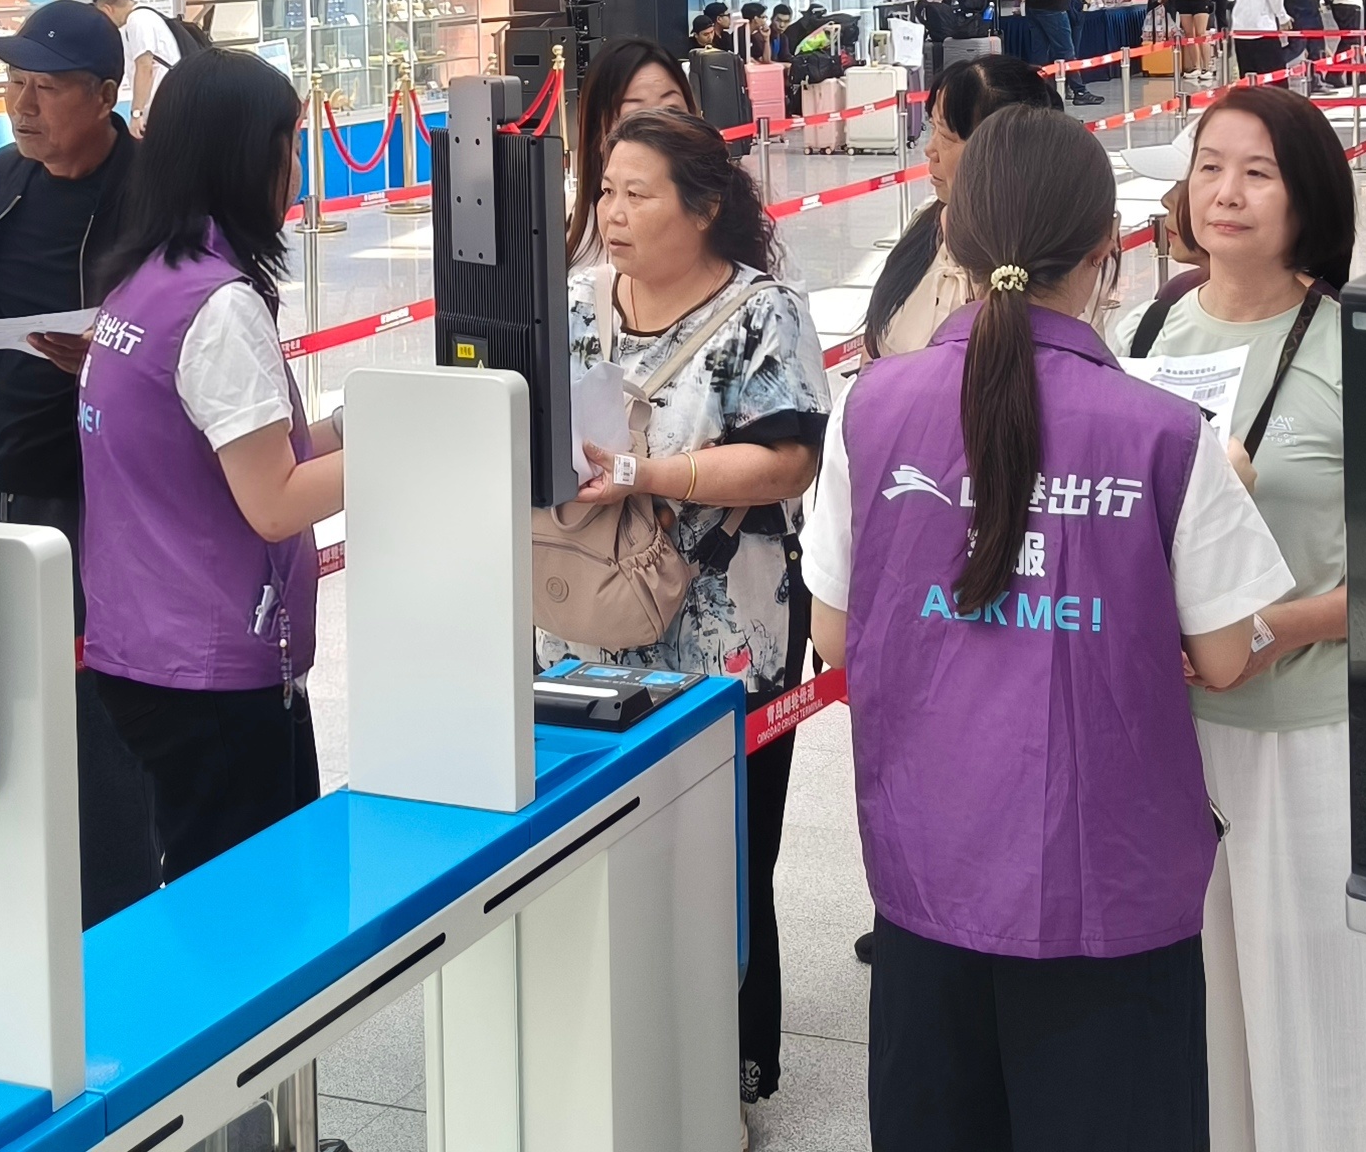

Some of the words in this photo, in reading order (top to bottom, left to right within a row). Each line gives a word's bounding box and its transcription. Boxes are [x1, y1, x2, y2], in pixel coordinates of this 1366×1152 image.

[967, 528, 1046, 577] 服
[766, 682, 815, 726] 青岛邮轮母港
